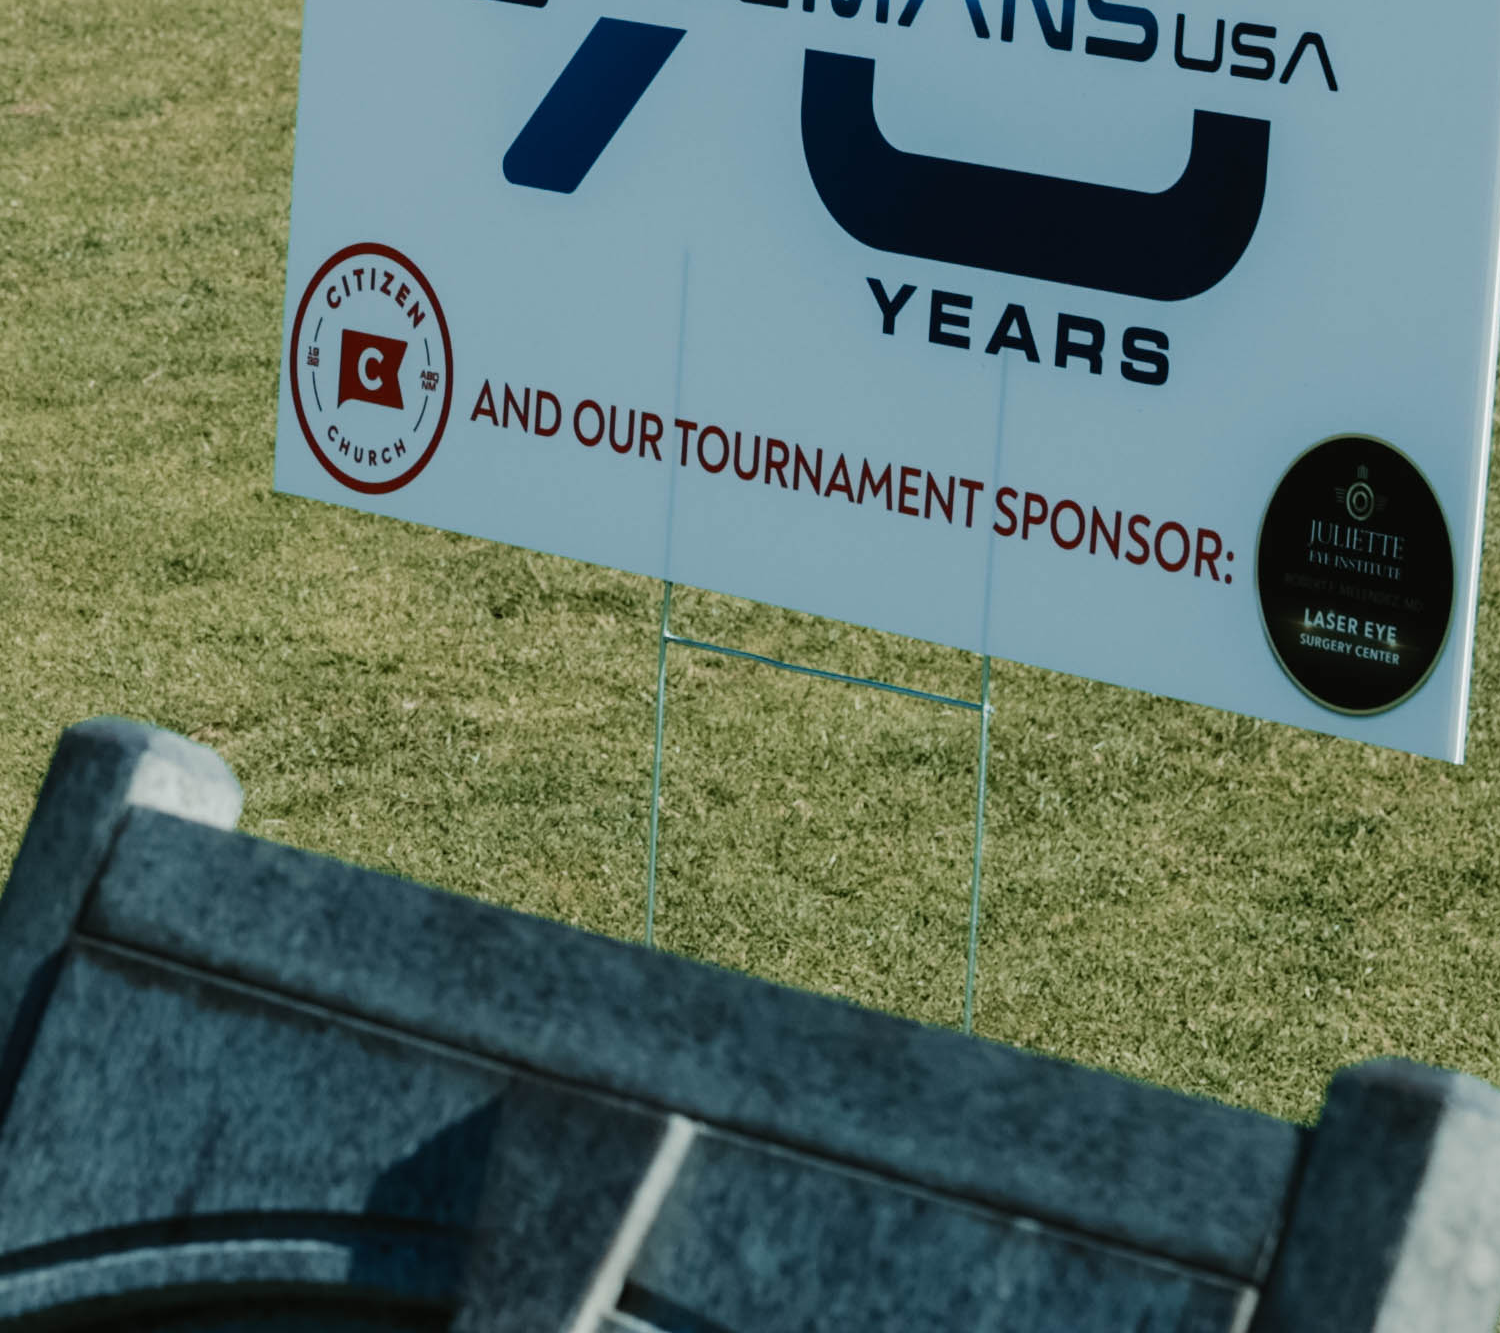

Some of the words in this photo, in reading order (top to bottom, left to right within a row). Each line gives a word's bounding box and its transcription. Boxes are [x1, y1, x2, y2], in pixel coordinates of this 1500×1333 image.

[1174, 13, 1339, 92] USA
[326, 268, 426, 329] CITIZEN
[866, 276, 1170, 386] YEARS
[357, 346, 385, 392] C
[327, 424, 407, 467] CHURCH
[470, 378, 562, 437] AND
[573, 399, 664, 462] OUR
[674, 418, 984, 528] TOURNAMENT
[992, 486, 1235, 584] SPONSOR:
[1307, 519, 1405, 560] JULIETTE
[1334, 554, 1402, 581] INSTITUTE
[1303, 607, 1358, 635] LASER
[1364, 620, 1398, 646] EYE
[1299, 633, 1353, 655] SURGERY
[1355, 643, 1401, 666] CENTER
